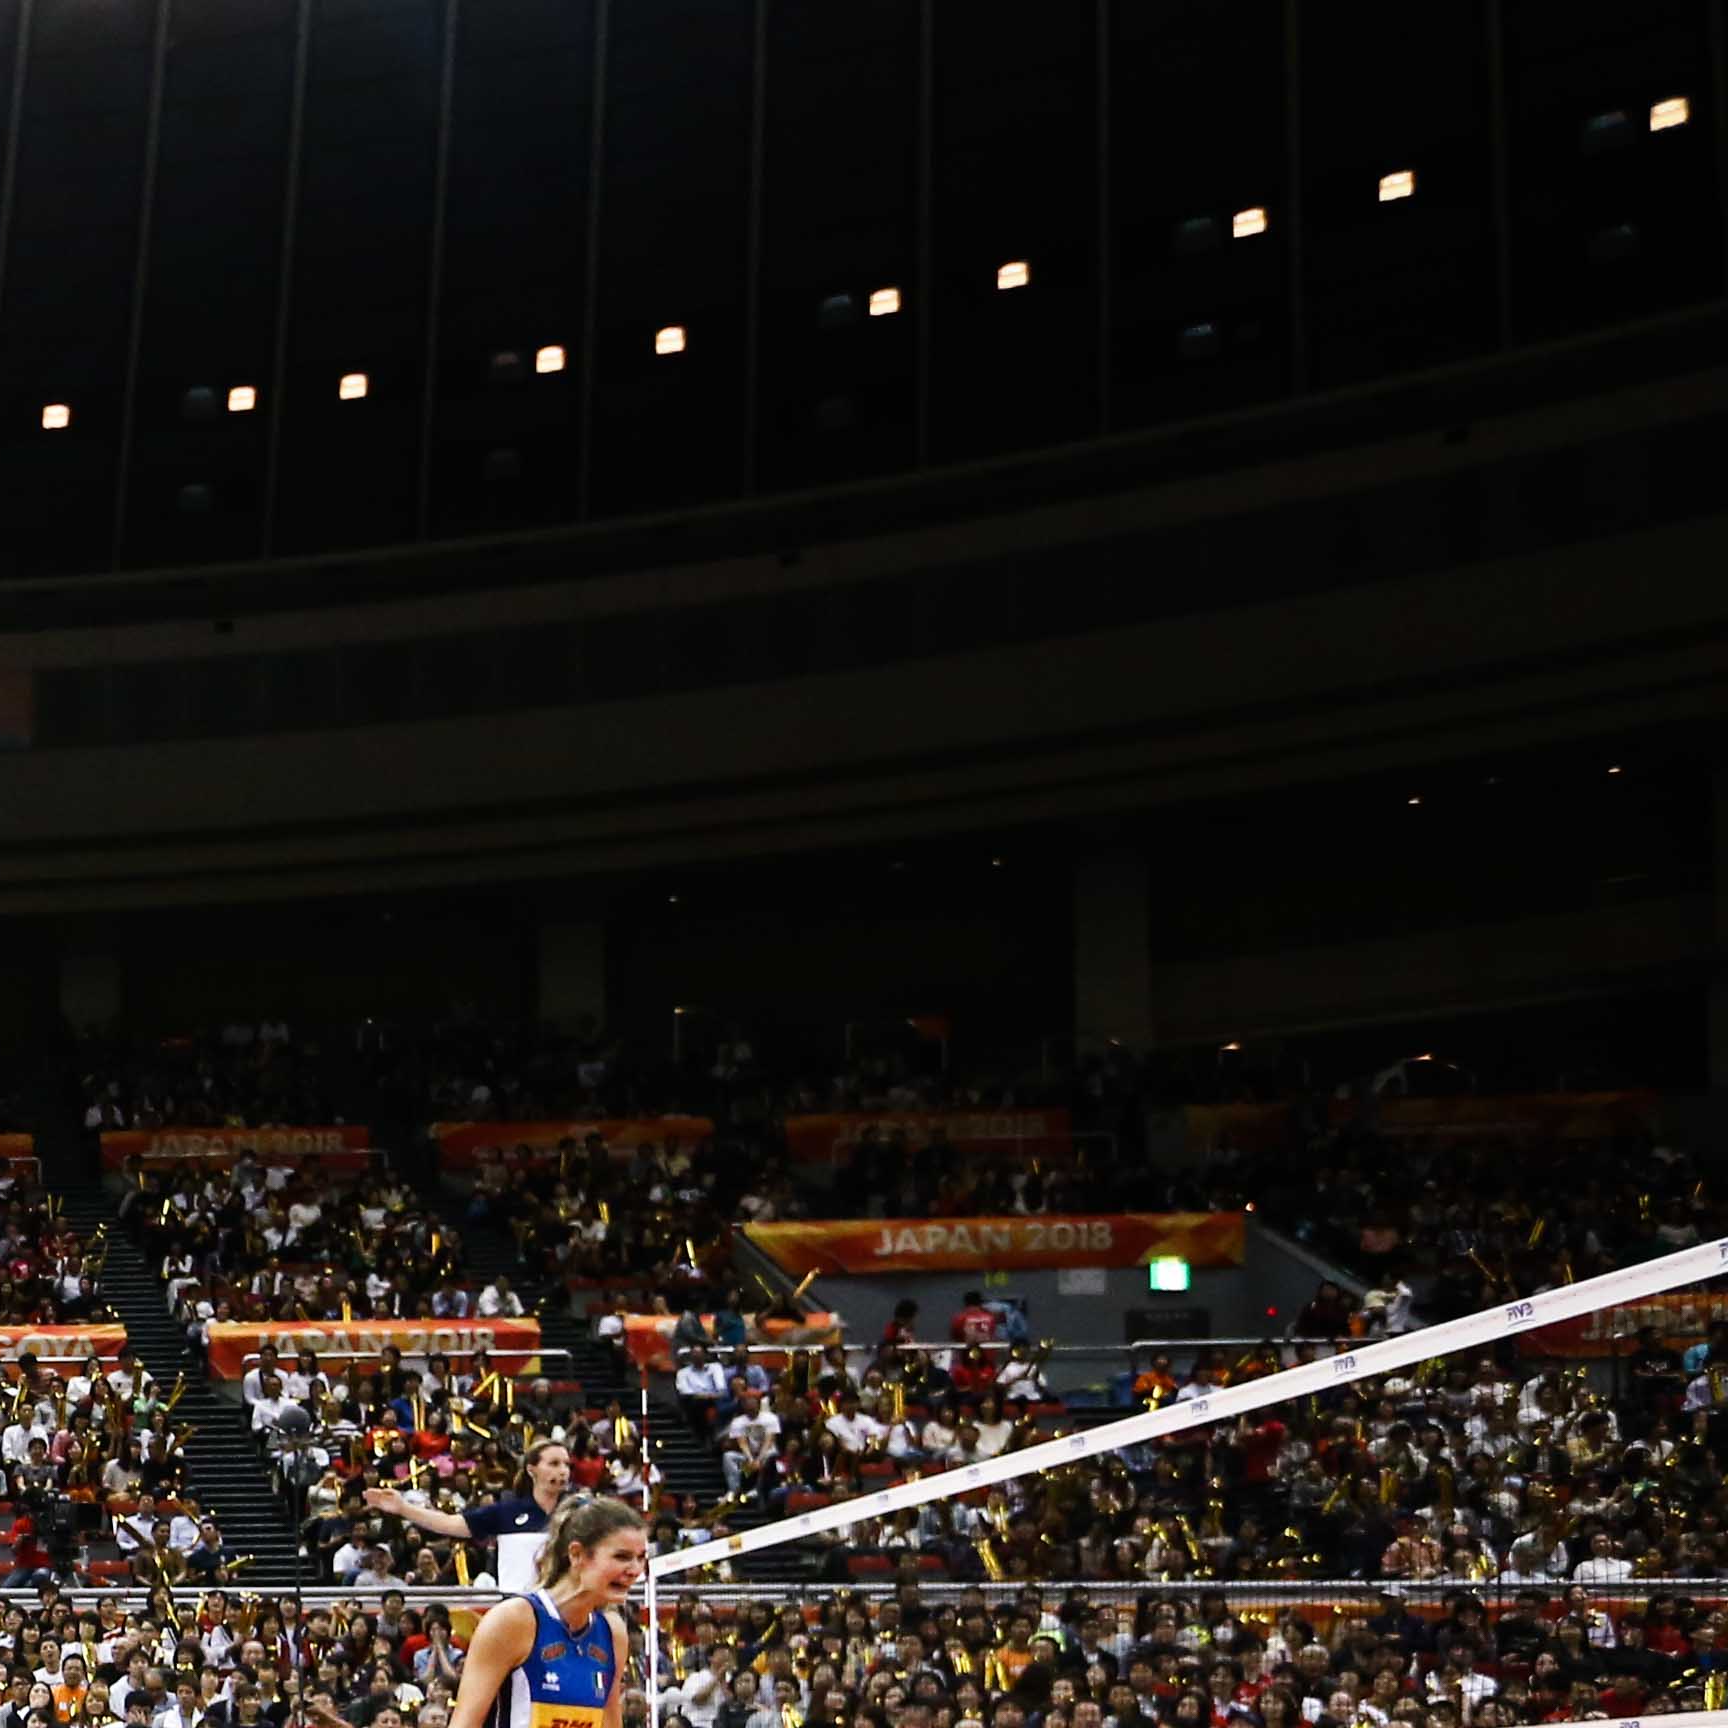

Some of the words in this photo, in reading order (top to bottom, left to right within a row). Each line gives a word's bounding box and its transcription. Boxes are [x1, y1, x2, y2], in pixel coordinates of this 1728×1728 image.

[874, 1226, 1011, 1257] JAPAN
[1023, 1223, 1113, 1251] 2018
[1506, 1301, 1534, 1320] FIVB
[258, 1330, 395, 1354] JAPAN
[407, 1327, 497, 1352] 2018
